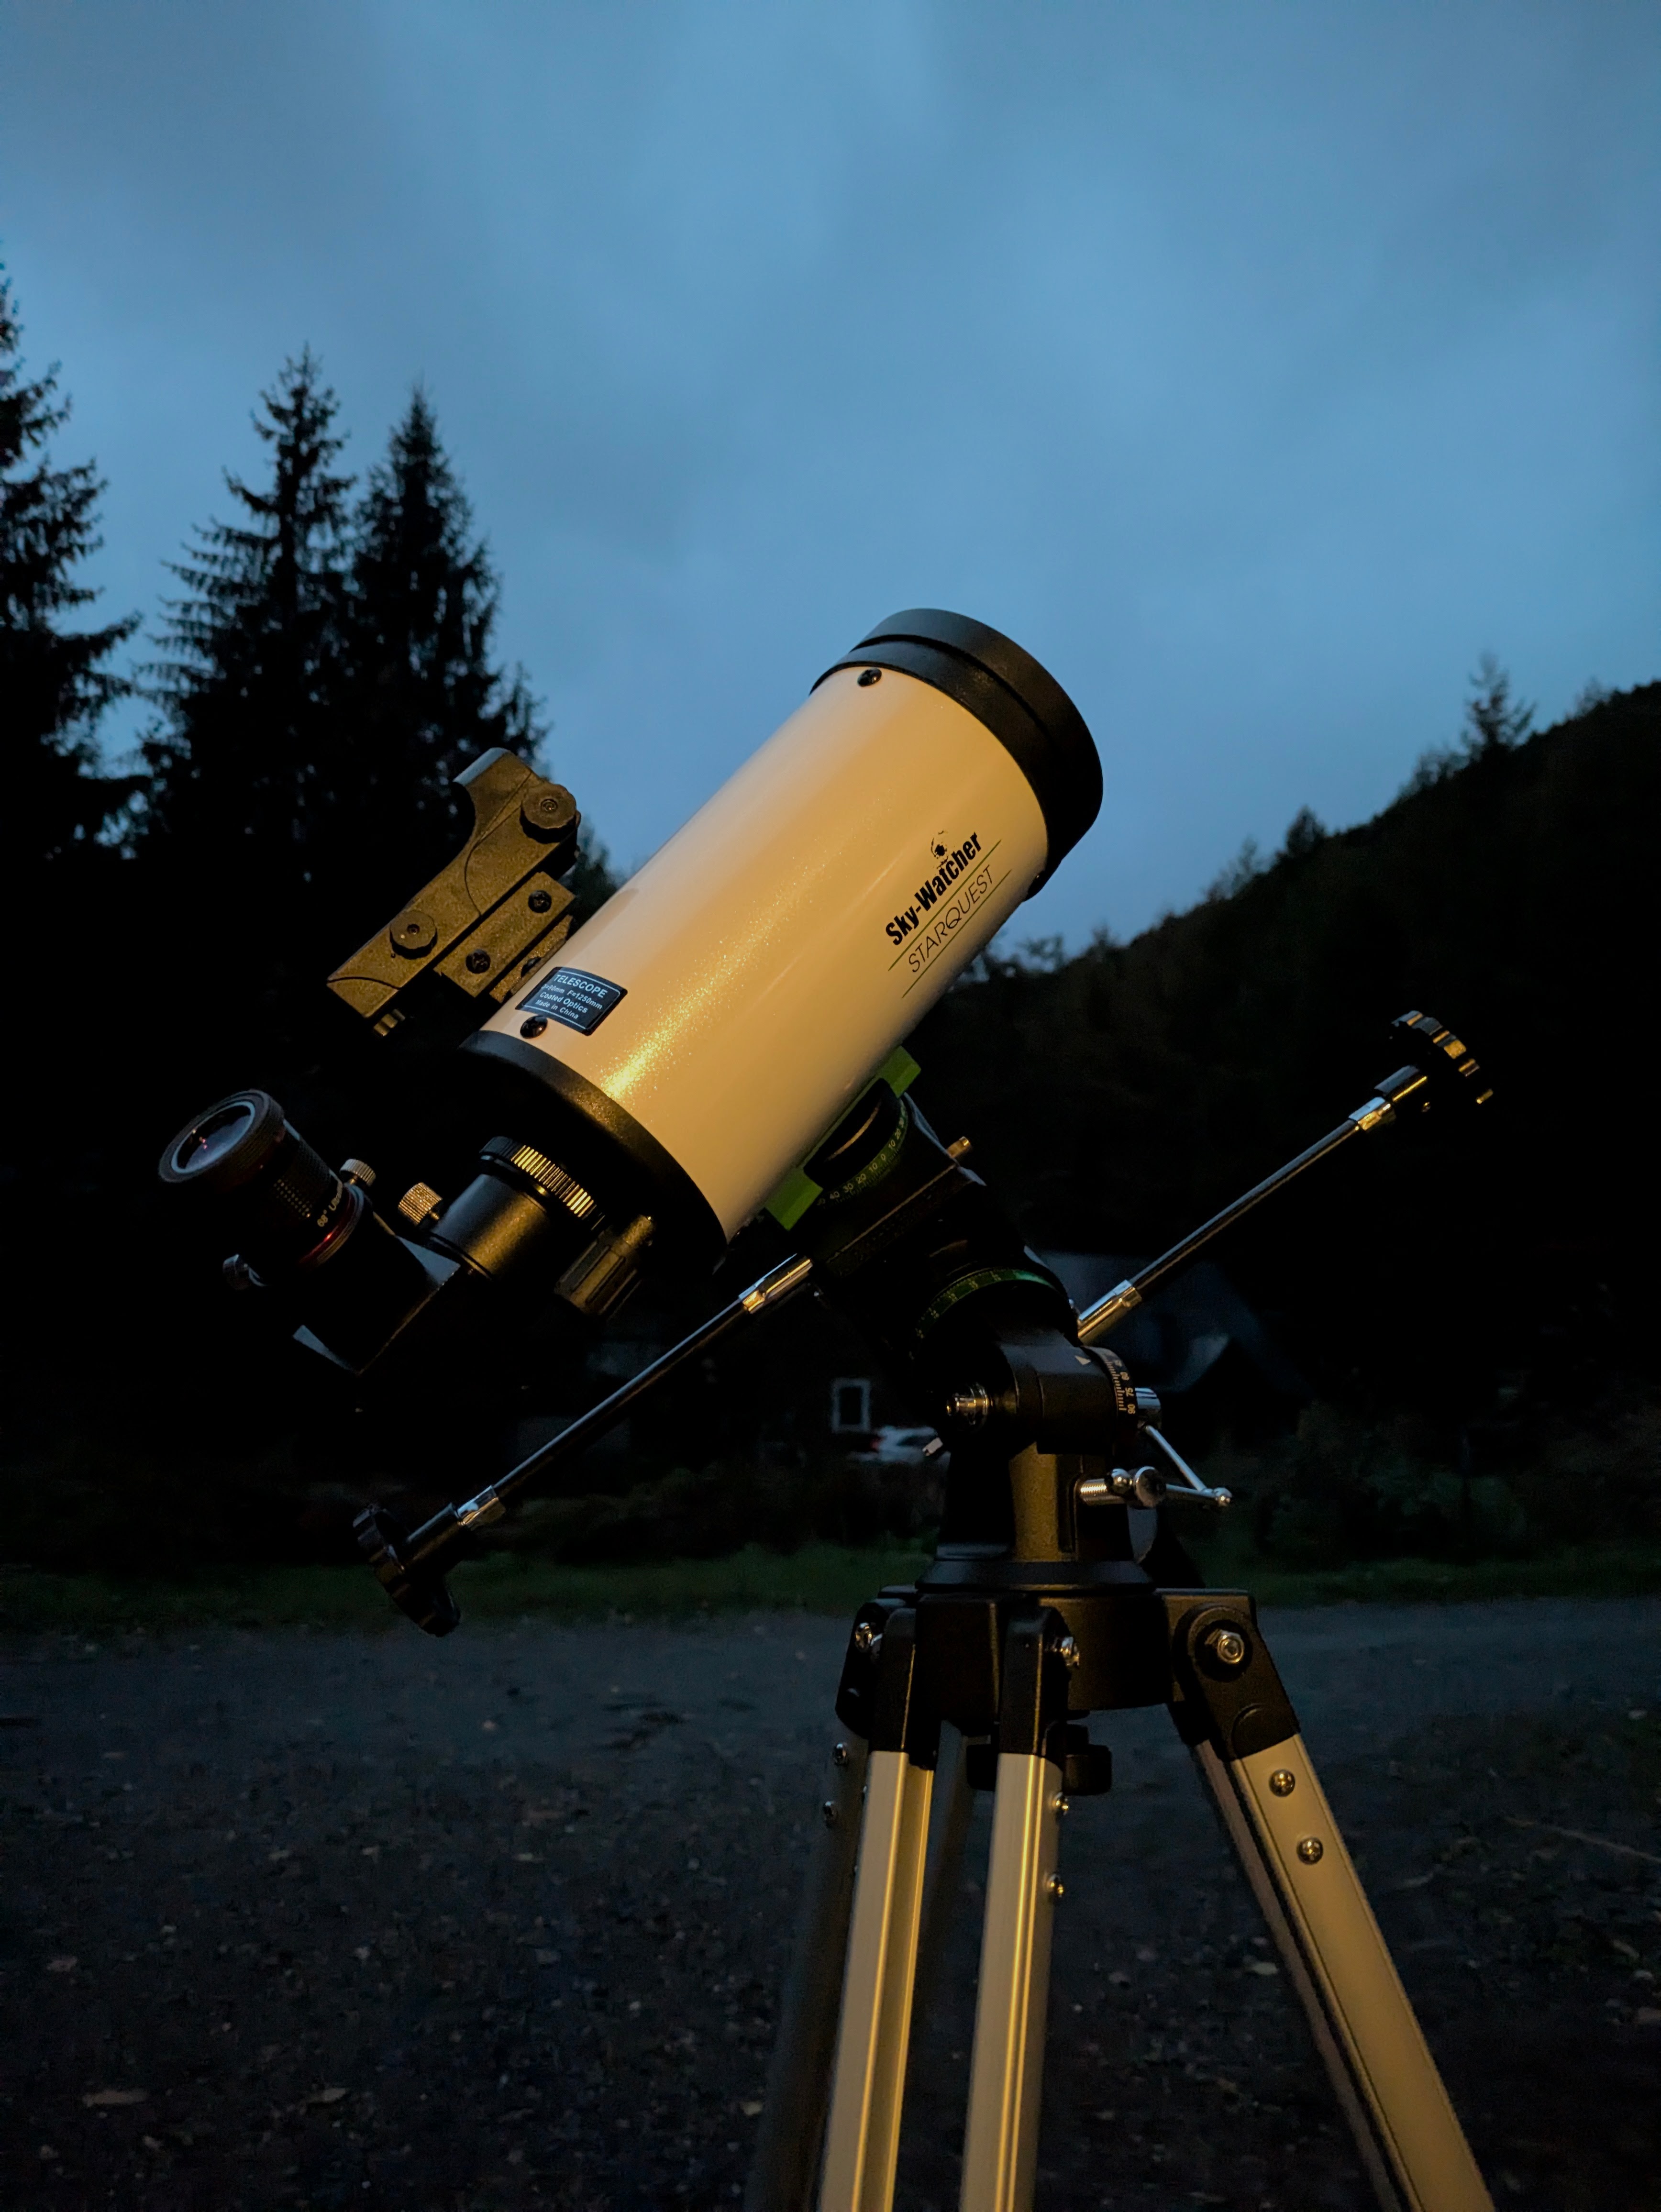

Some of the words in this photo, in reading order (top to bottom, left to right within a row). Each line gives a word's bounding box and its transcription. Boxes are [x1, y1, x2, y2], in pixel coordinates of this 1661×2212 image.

[885, 832, 982, 945] Sky-Watcher
[908, 864, 993, 973] STARQUEST
[554, 974, 608, 998] TELESCOPE
[535, 999, 551, 1007] Made
[559, 1007, 579, 1019] China
[540, 991, 565, 1002] Coated
[563, 998, 588, 1013] Optics
[567, 990, 603, 1010] F=1250mm
[843, 1183, 853, 1193] 30
[856, 1173, 866, 1184] 20
[869, 1162, 878, 1172] 10
[888, 1139, 896, 1148] 10
[1125, 1387, 1134, 1397] 75
[1127, 1404, 1136, 1415] 90
